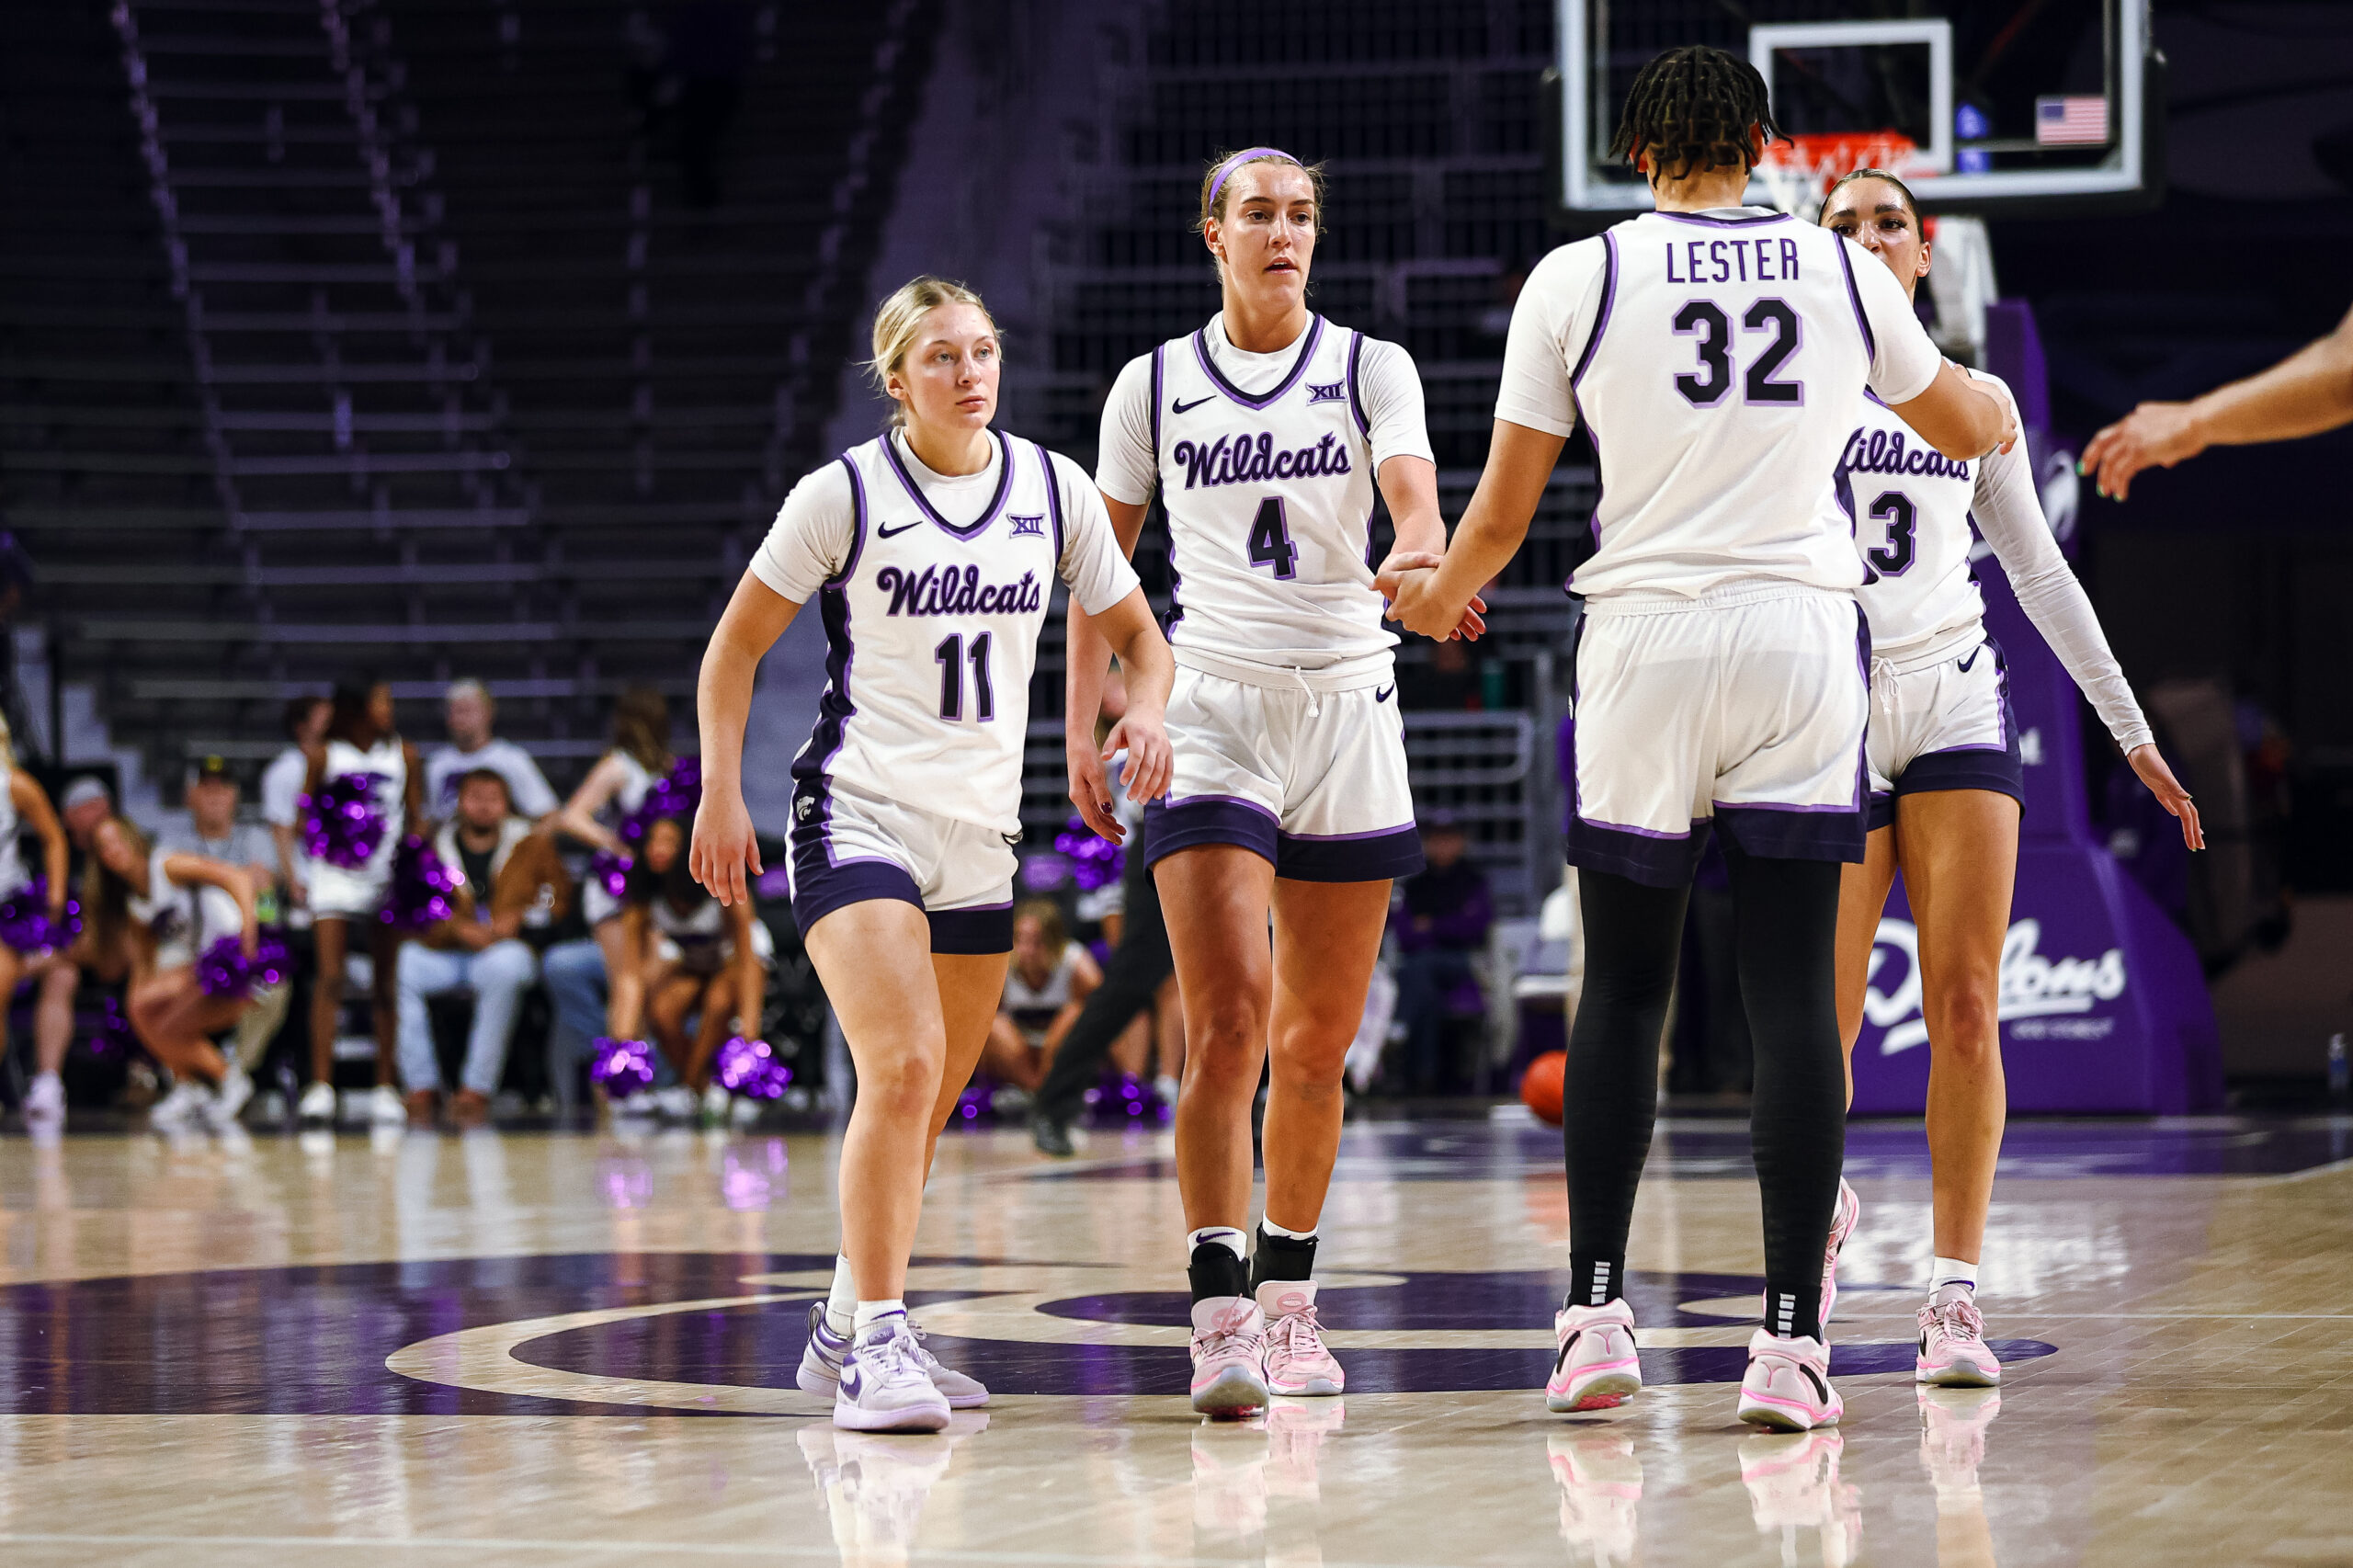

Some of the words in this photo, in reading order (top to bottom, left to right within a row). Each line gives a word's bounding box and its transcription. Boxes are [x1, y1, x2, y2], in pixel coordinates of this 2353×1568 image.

[1666, 238, 1799, 283] LESTER
[1671, 297, 1804, 410] 32
[1308, 381, 1346, 403] XII
[1174, 430, 1351, 491] Wildcats
[1010, 516, 1044, 535] XII
[1246, 495, 1299, 581] 4
[1868, 491, 1916, 577] 3
[876, 563, 1040, 617] Wildcats
[935, 631, 995, 722] 11
